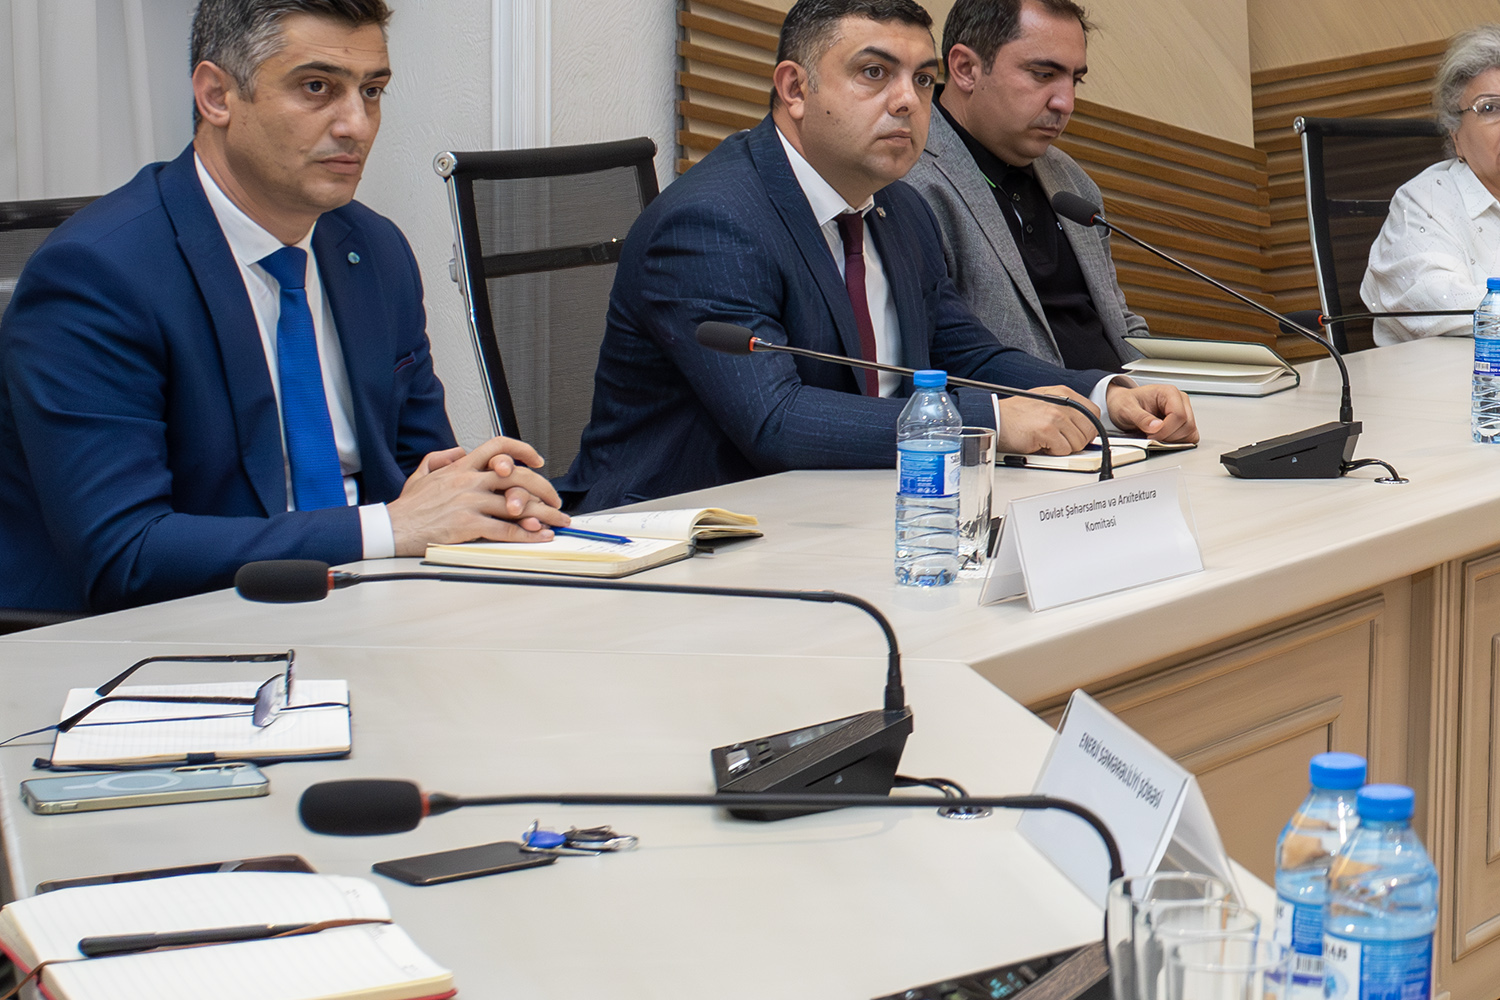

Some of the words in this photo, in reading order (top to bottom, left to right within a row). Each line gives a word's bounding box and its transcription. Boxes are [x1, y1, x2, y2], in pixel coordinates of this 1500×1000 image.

[1039, 506, 1065, 522] Dövlət
[1065, 499, 1107, 519] Şəhərsalma
[1107, 497, 1117, 508] və
[1118, 488, 1157, 506] Arxitektura
[1084, 515, 1117, 532] Komitəsi
